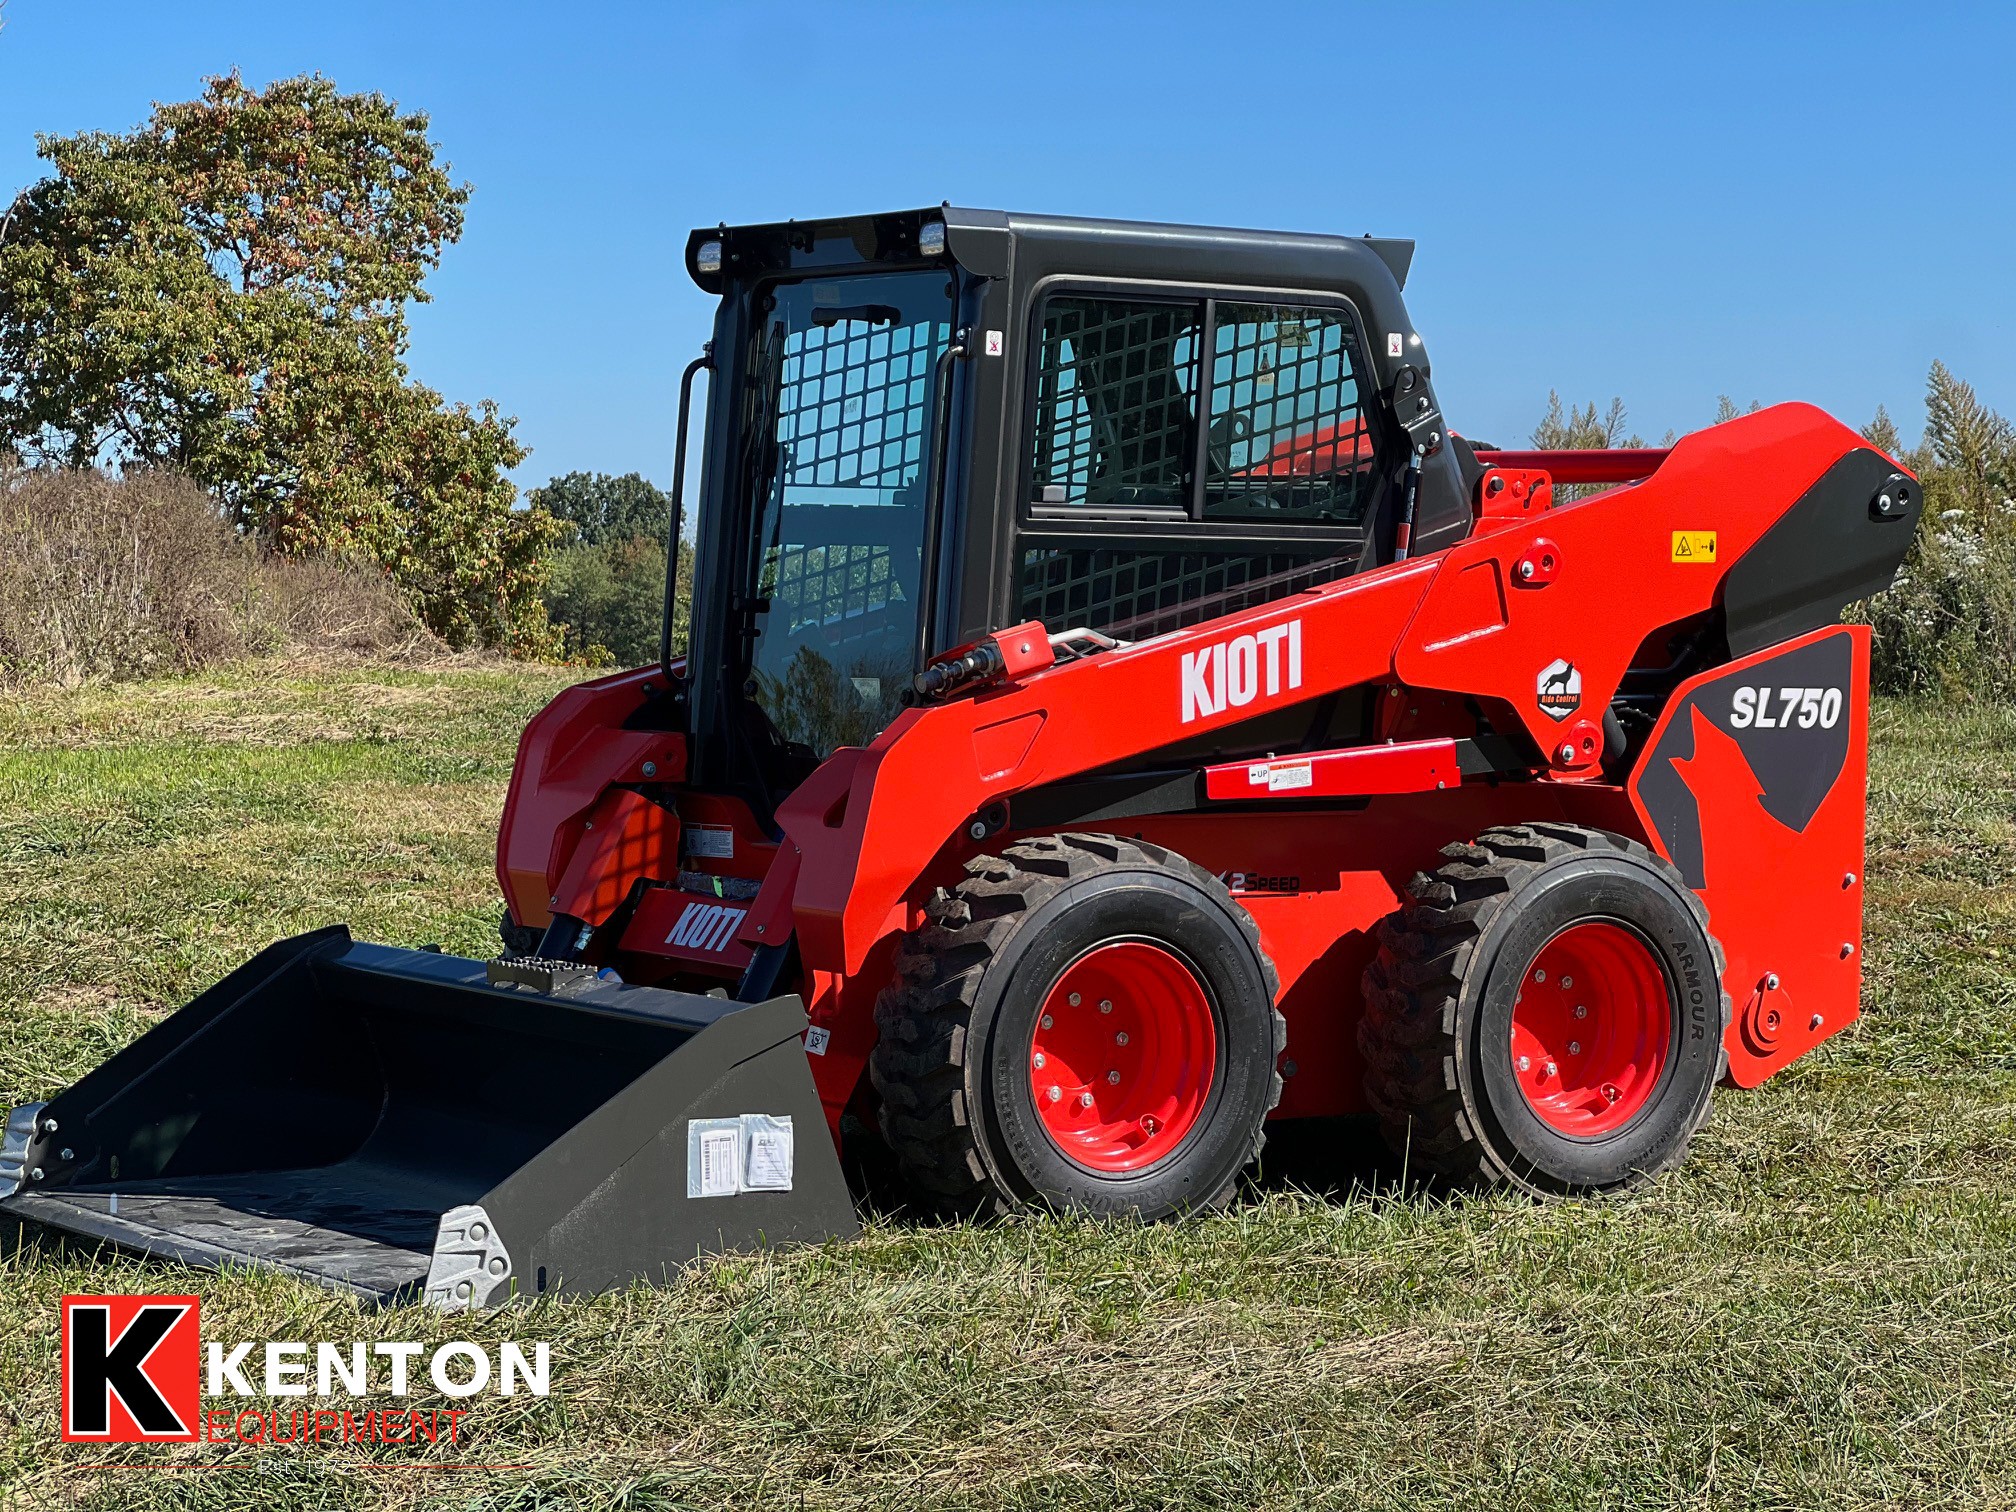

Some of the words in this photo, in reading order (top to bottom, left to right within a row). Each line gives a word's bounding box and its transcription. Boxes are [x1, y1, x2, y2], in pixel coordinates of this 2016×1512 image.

[1181, 619, 1301, 723] KIOTI
[1541, 695, 1555, 703] Ride
[1556, 695, 1578, 703] Control
[1730, 686, 1842, 728] SL750
[1257, 769, 1268, 778] UP
[664, 902, 747, 952] KIOTI
[1671, 941, 1706, 1040] ARMOUR
